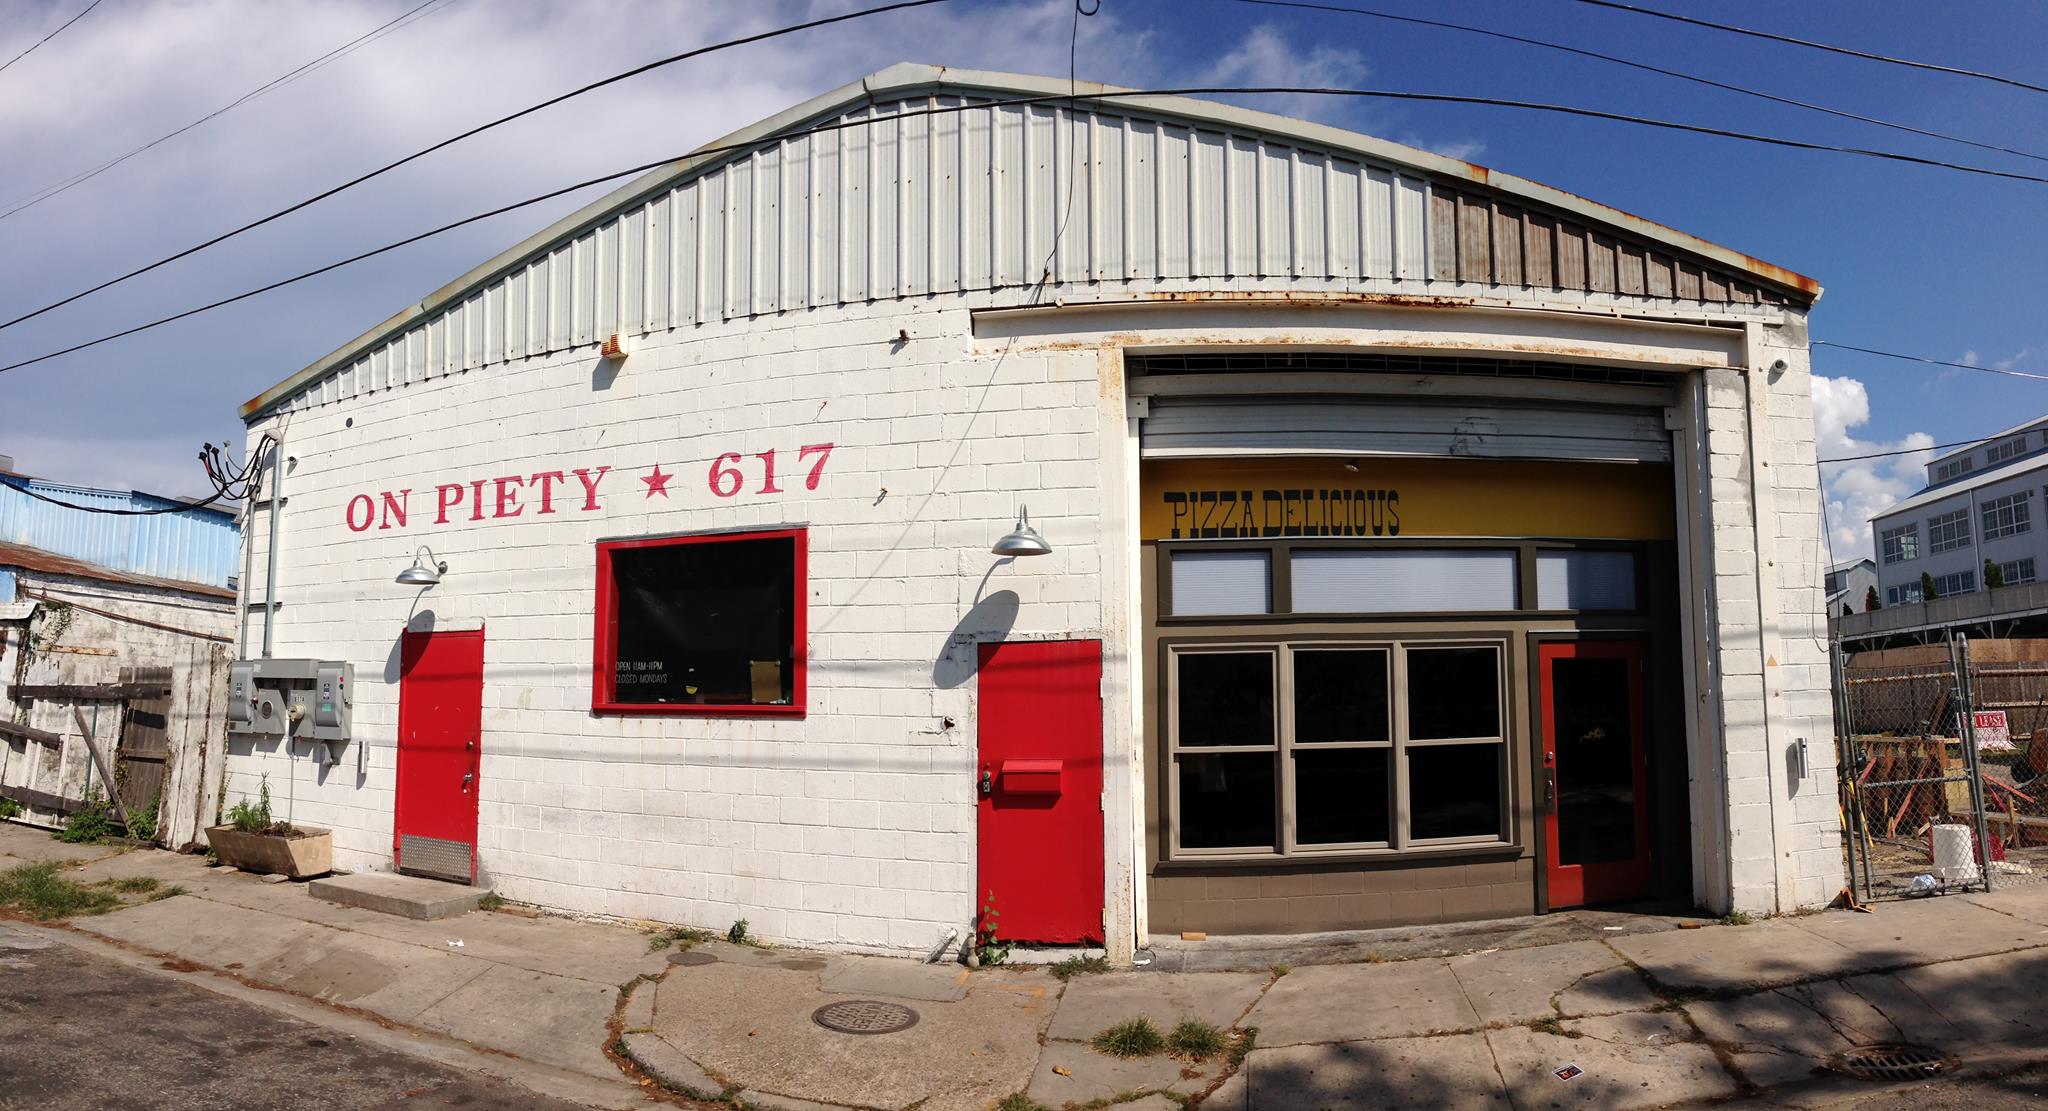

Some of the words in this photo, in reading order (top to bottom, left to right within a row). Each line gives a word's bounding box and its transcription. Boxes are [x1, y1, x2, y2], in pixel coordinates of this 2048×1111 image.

[346, 490, 412, 532] ON
[434, 465, 611, 524] PIETY
[709, 443, 835, 497] 617
[1164, 491, 1259, 539] PIZZA
[1263, 489, 1400, 537] DELICIOUS
[615, 661, 631, 671] OPEN
[615, 673, 638, 683] CLOSED
[640, 673, 668, 684] MONDAYS
[1979, 715, 2003, 727] LEASE
